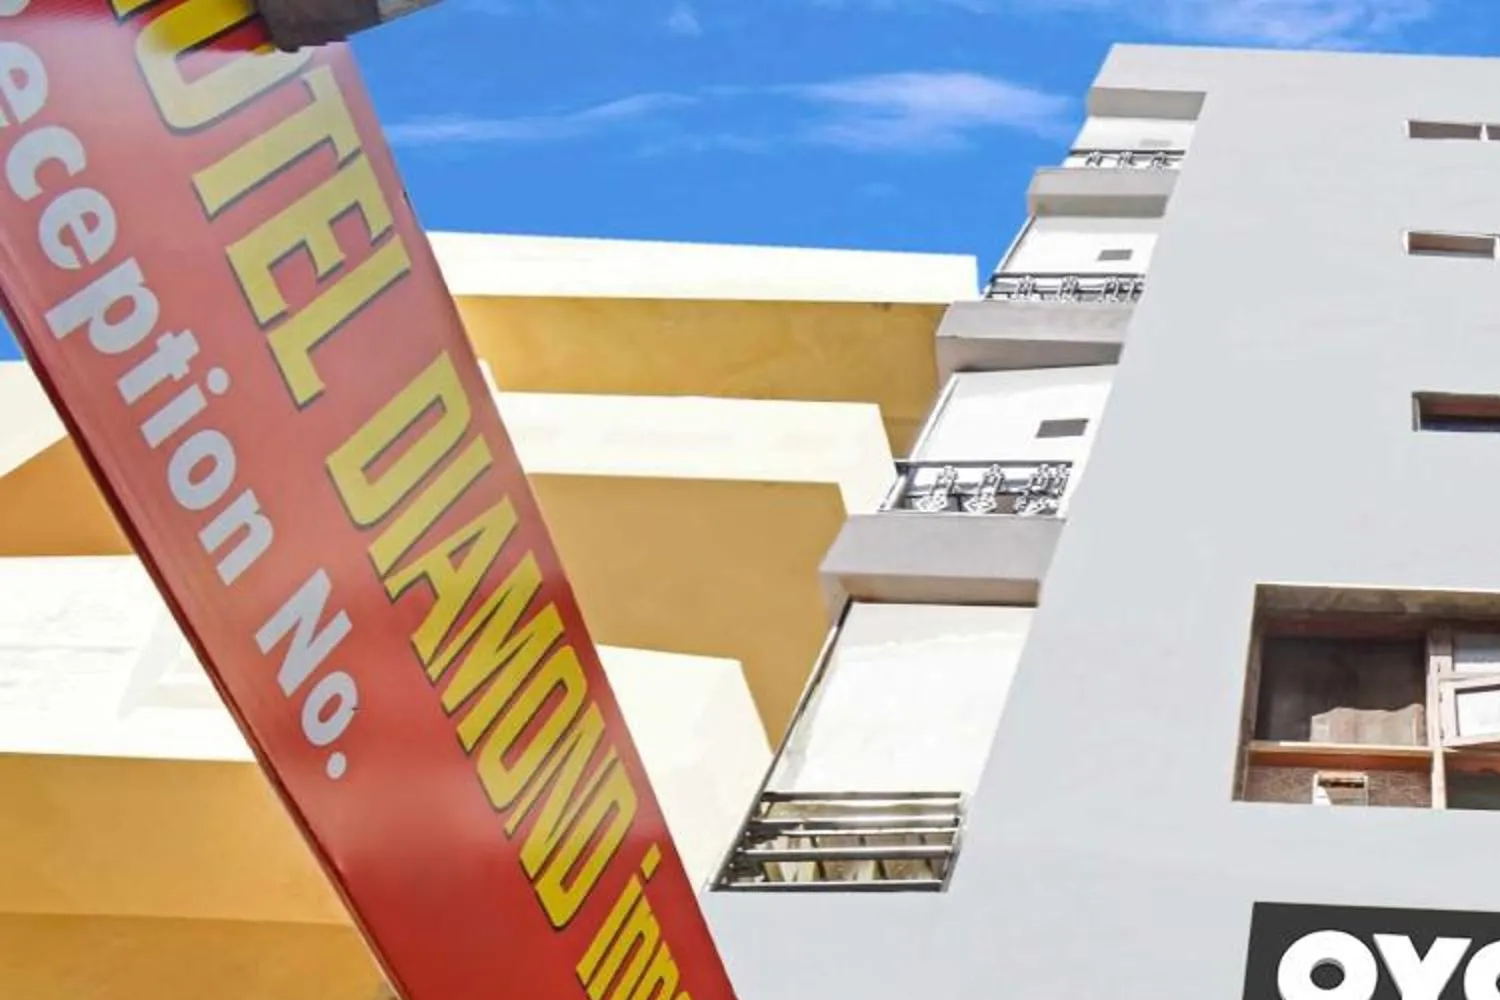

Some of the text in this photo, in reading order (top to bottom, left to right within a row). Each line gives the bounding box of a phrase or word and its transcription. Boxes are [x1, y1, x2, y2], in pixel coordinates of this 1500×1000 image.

[0, 0, 359, 781] eception No.
[108, 0, 411, 412] OTEL
[325, 350, 639, 931] DIAMOND
